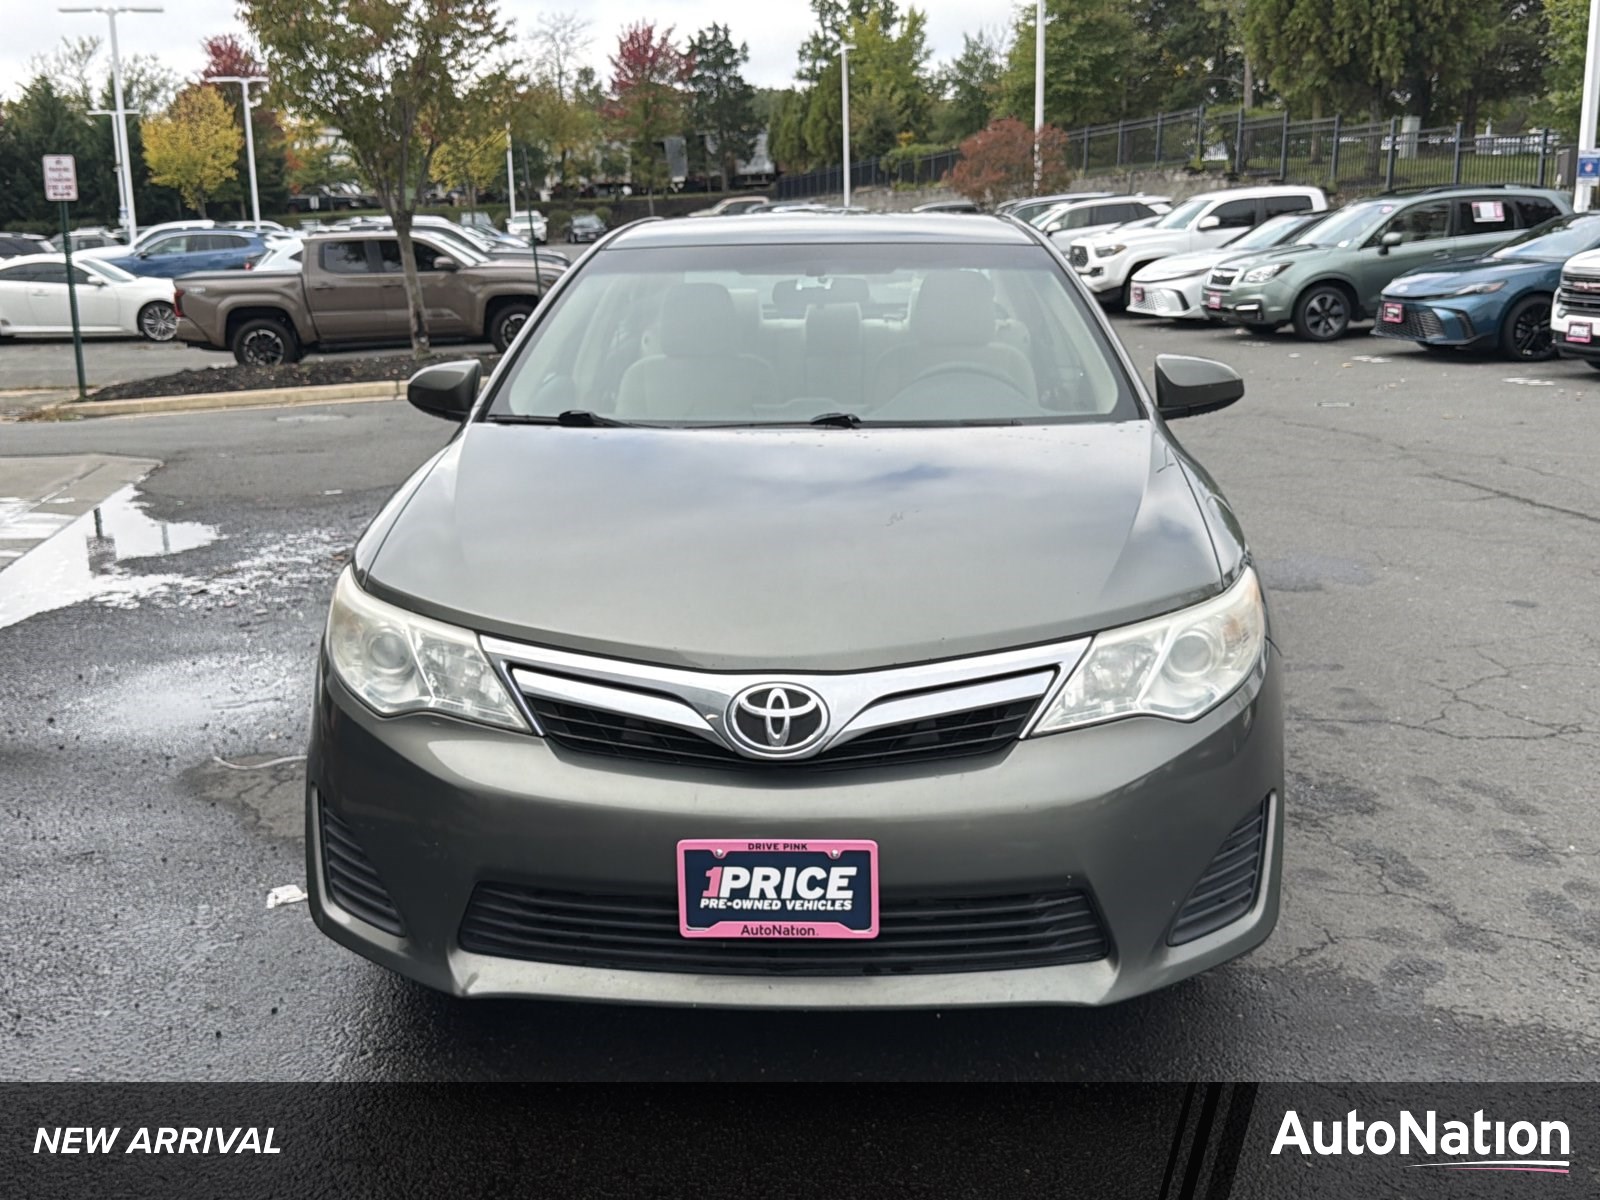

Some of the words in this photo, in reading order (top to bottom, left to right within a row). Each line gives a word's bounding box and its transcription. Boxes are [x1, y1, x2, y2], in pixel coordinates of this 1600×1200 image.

[747, 842, 780, 851] DRIVE
[783, 842, 808, 851] PINK
[700, 898, 781, 911] PRE-OWNED
[786, 899, 852, 911] VEHICLES
[741, 924, 816, 937] AutoNation
